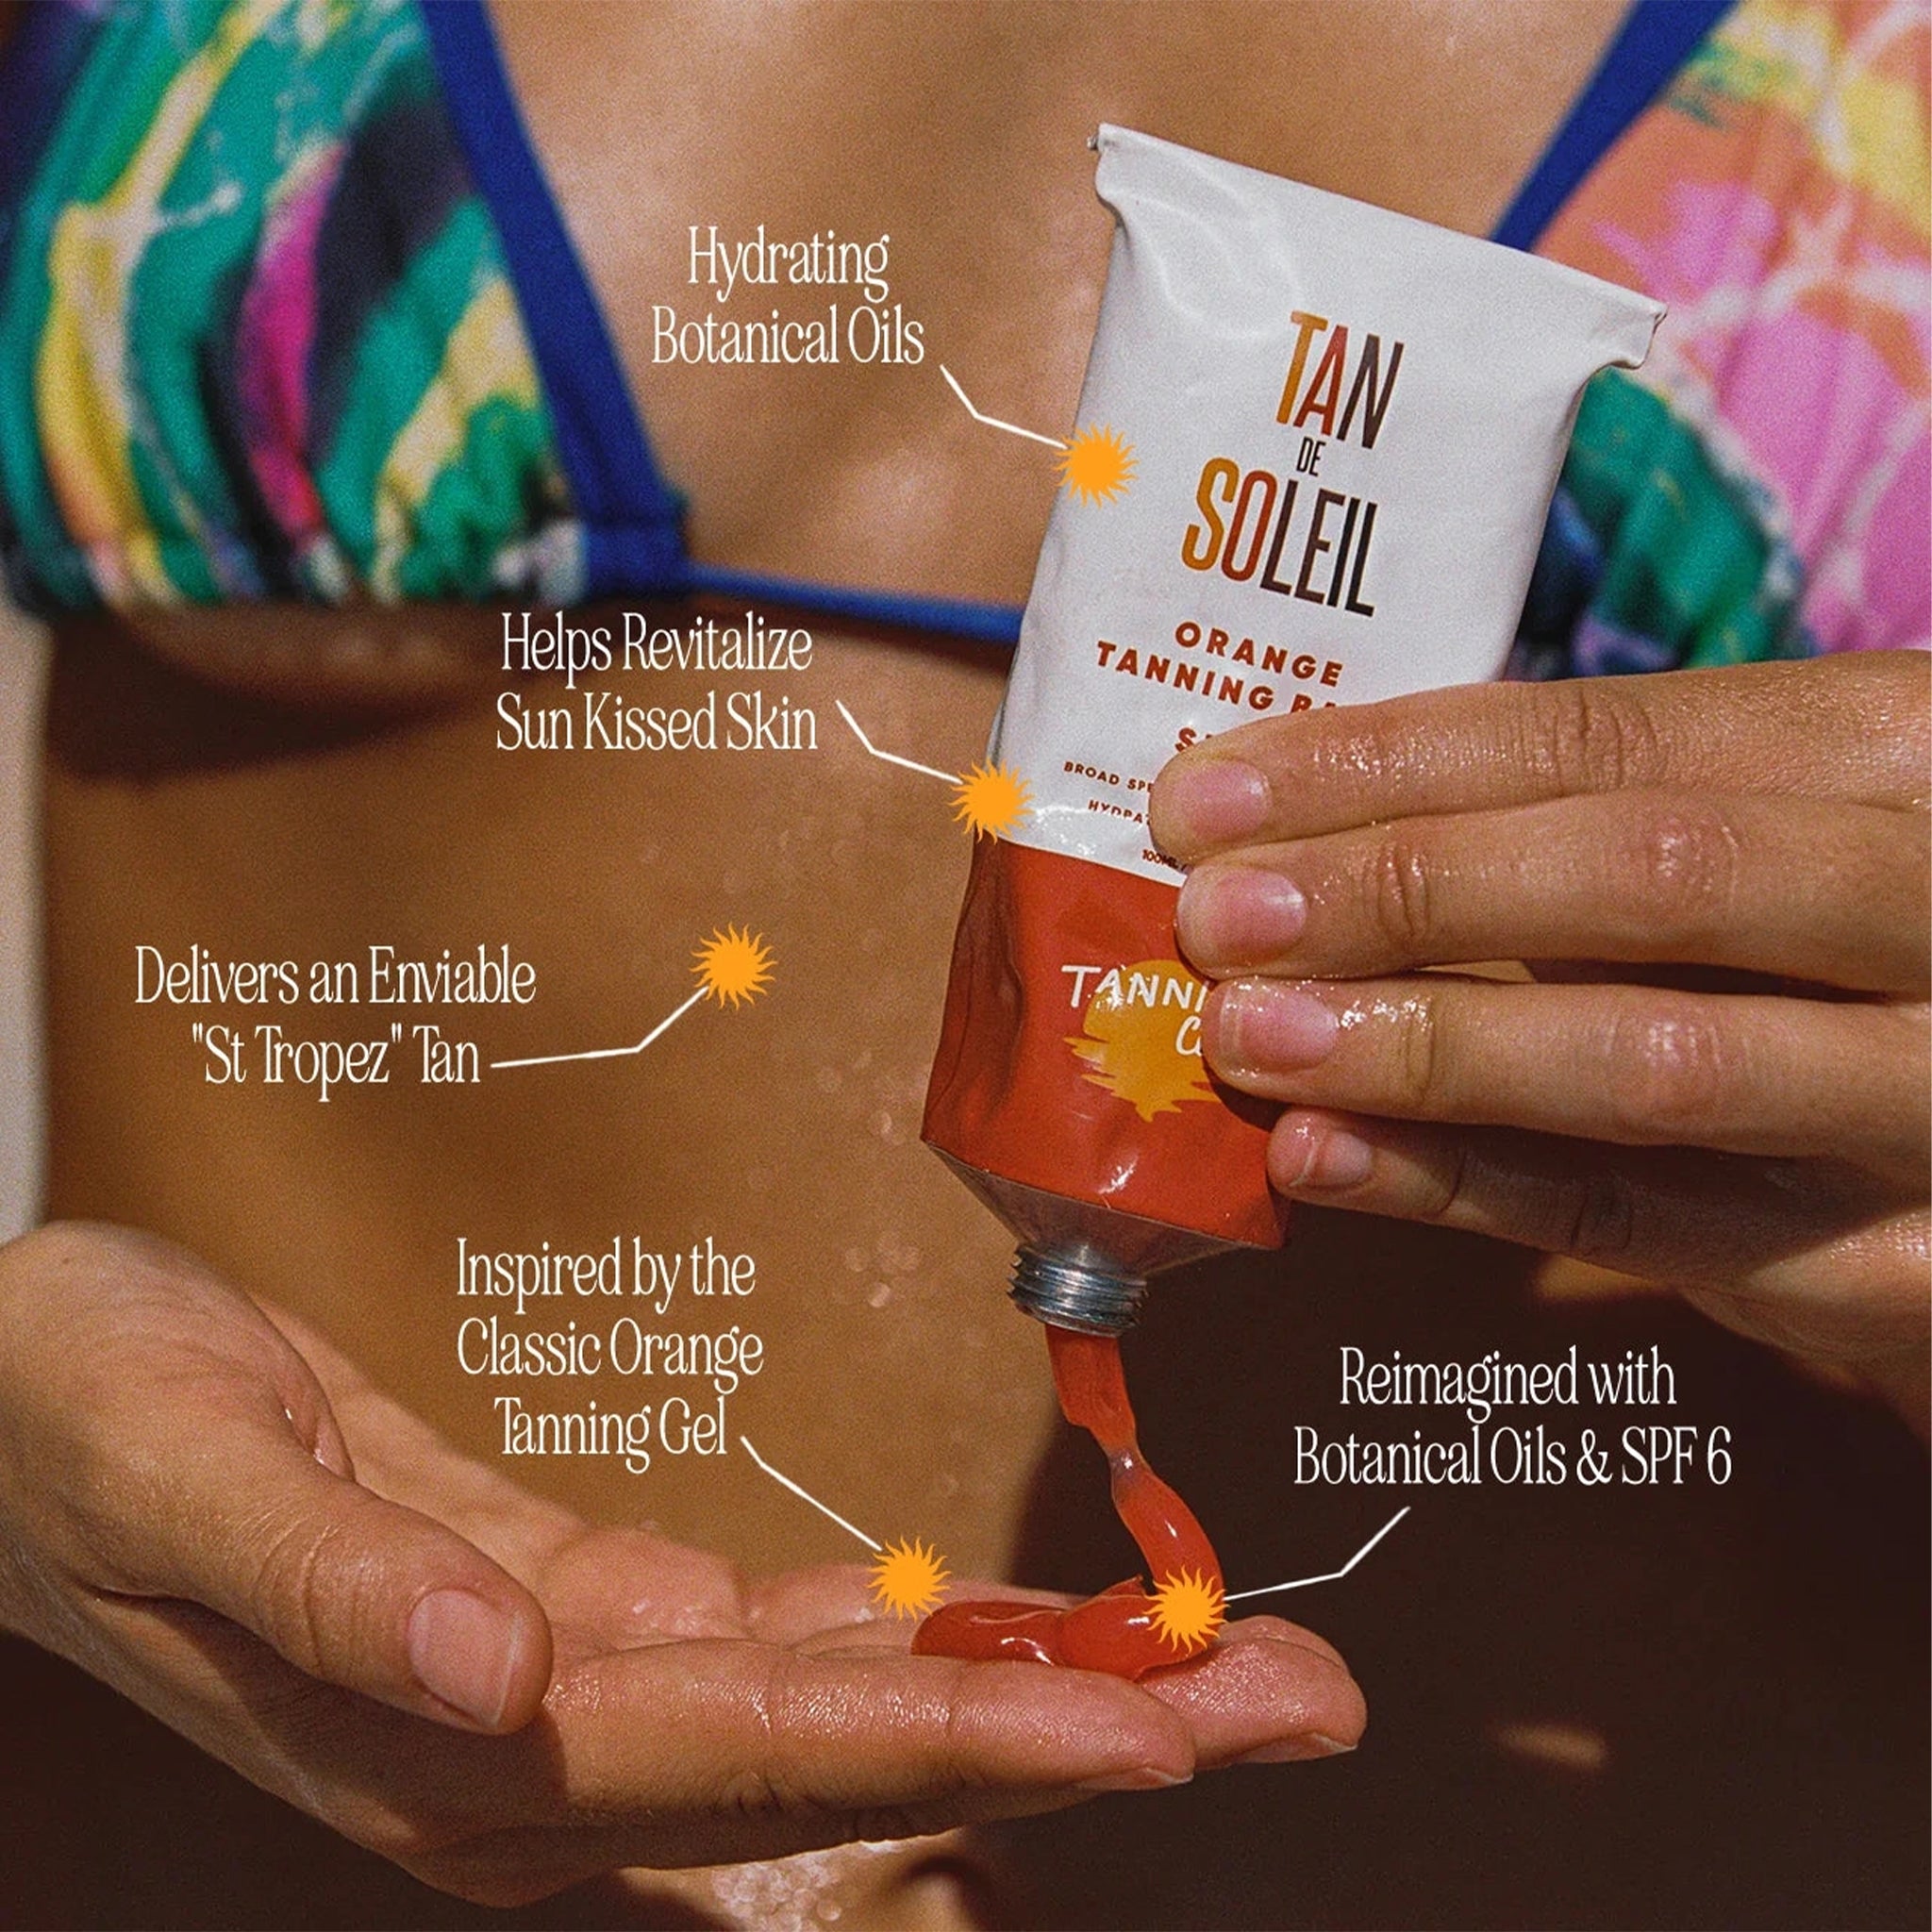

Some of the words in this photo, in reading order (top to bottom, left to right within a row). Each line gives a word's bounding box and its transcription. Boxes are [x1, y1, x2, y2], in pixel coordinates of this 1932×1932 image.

[1276, 310, 1404, 449] TAN
[1296, 437, 1326, 476] DE
[1181, 457, 1377, 617] SOLEIL
[1097, 641, 1274, 710] TANNING
[1175, 622, 1342, 687] ORANGE
[1064, 761, 1120, 785] BROAD
